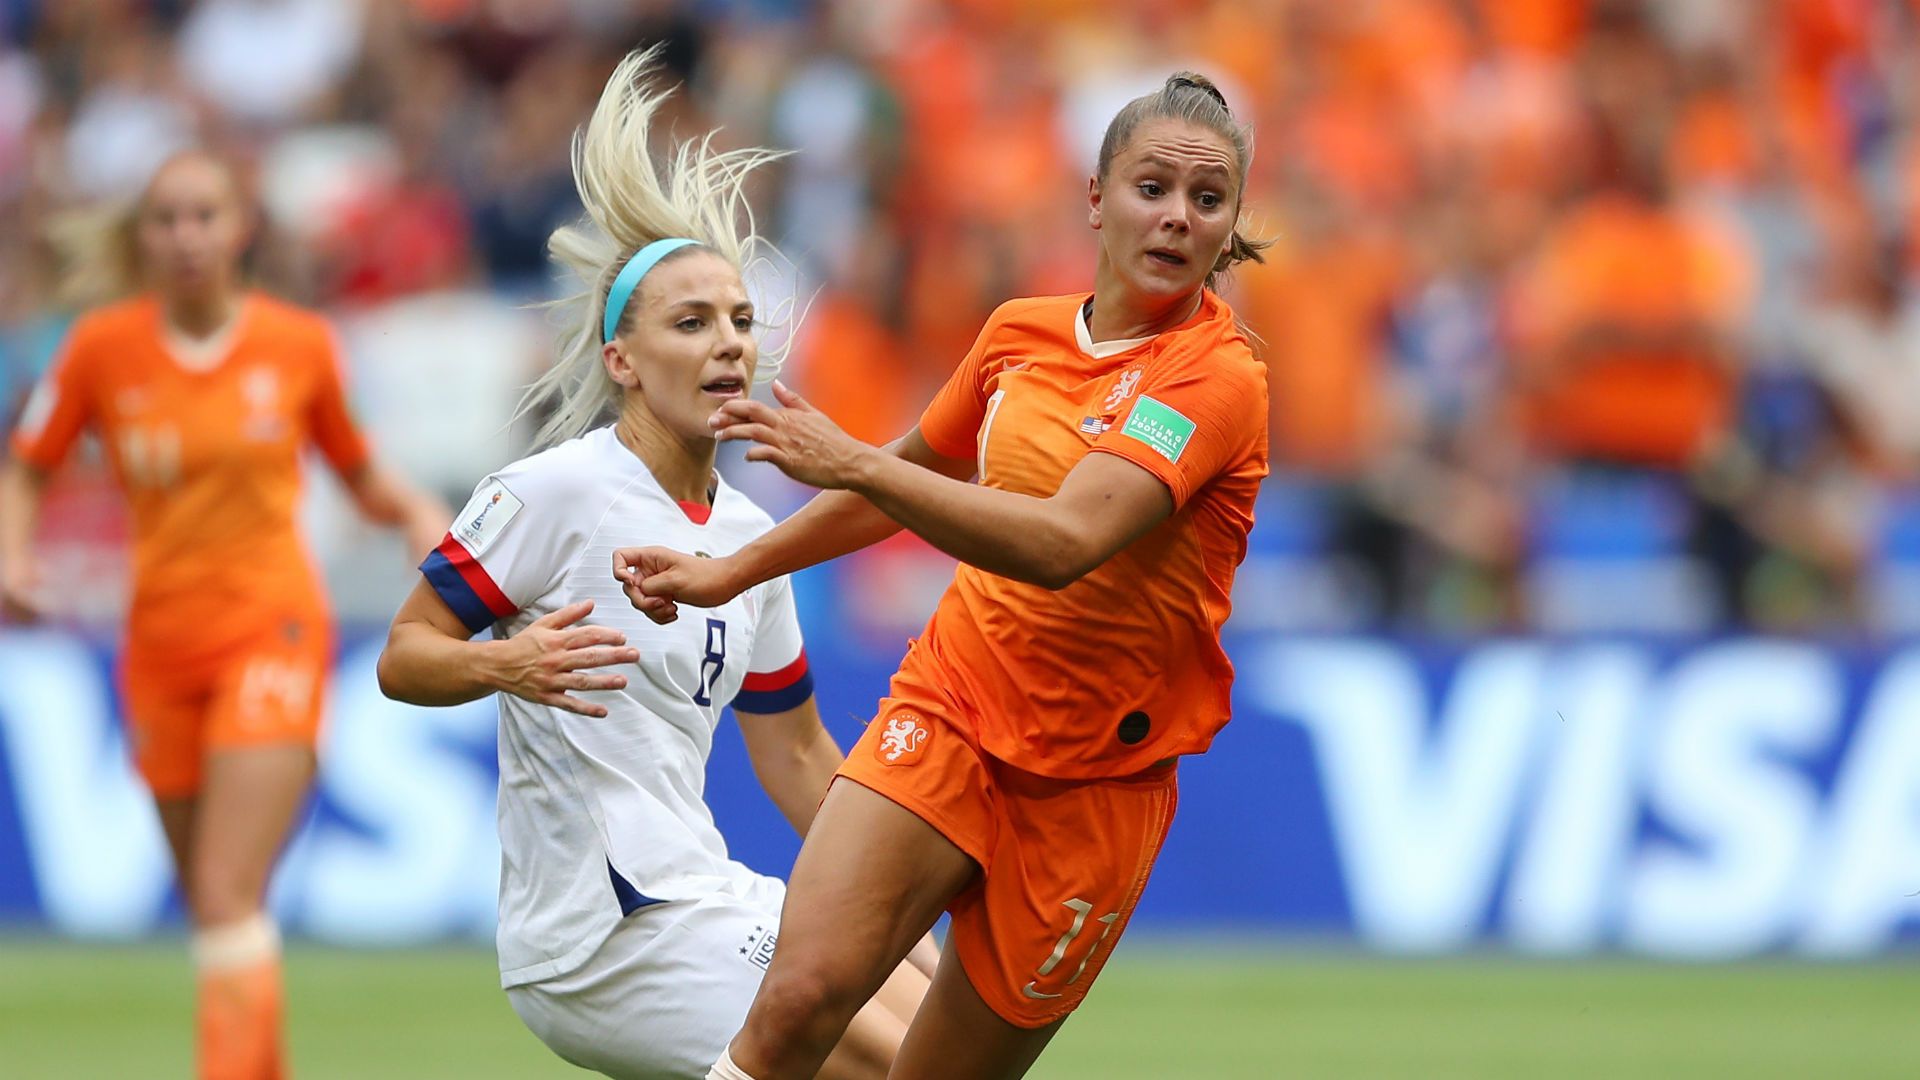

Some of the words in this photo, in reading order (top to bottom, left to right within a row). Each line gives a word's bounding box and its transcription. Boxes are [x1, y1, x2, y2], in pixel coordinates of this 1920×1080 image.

[1131, 419, 1180, 450] FOOTBALL
[1133, 413, 1182, 443] LIVING
[692, 617, 726, 707] 8
[1038, 897, 1120, 985] 11
